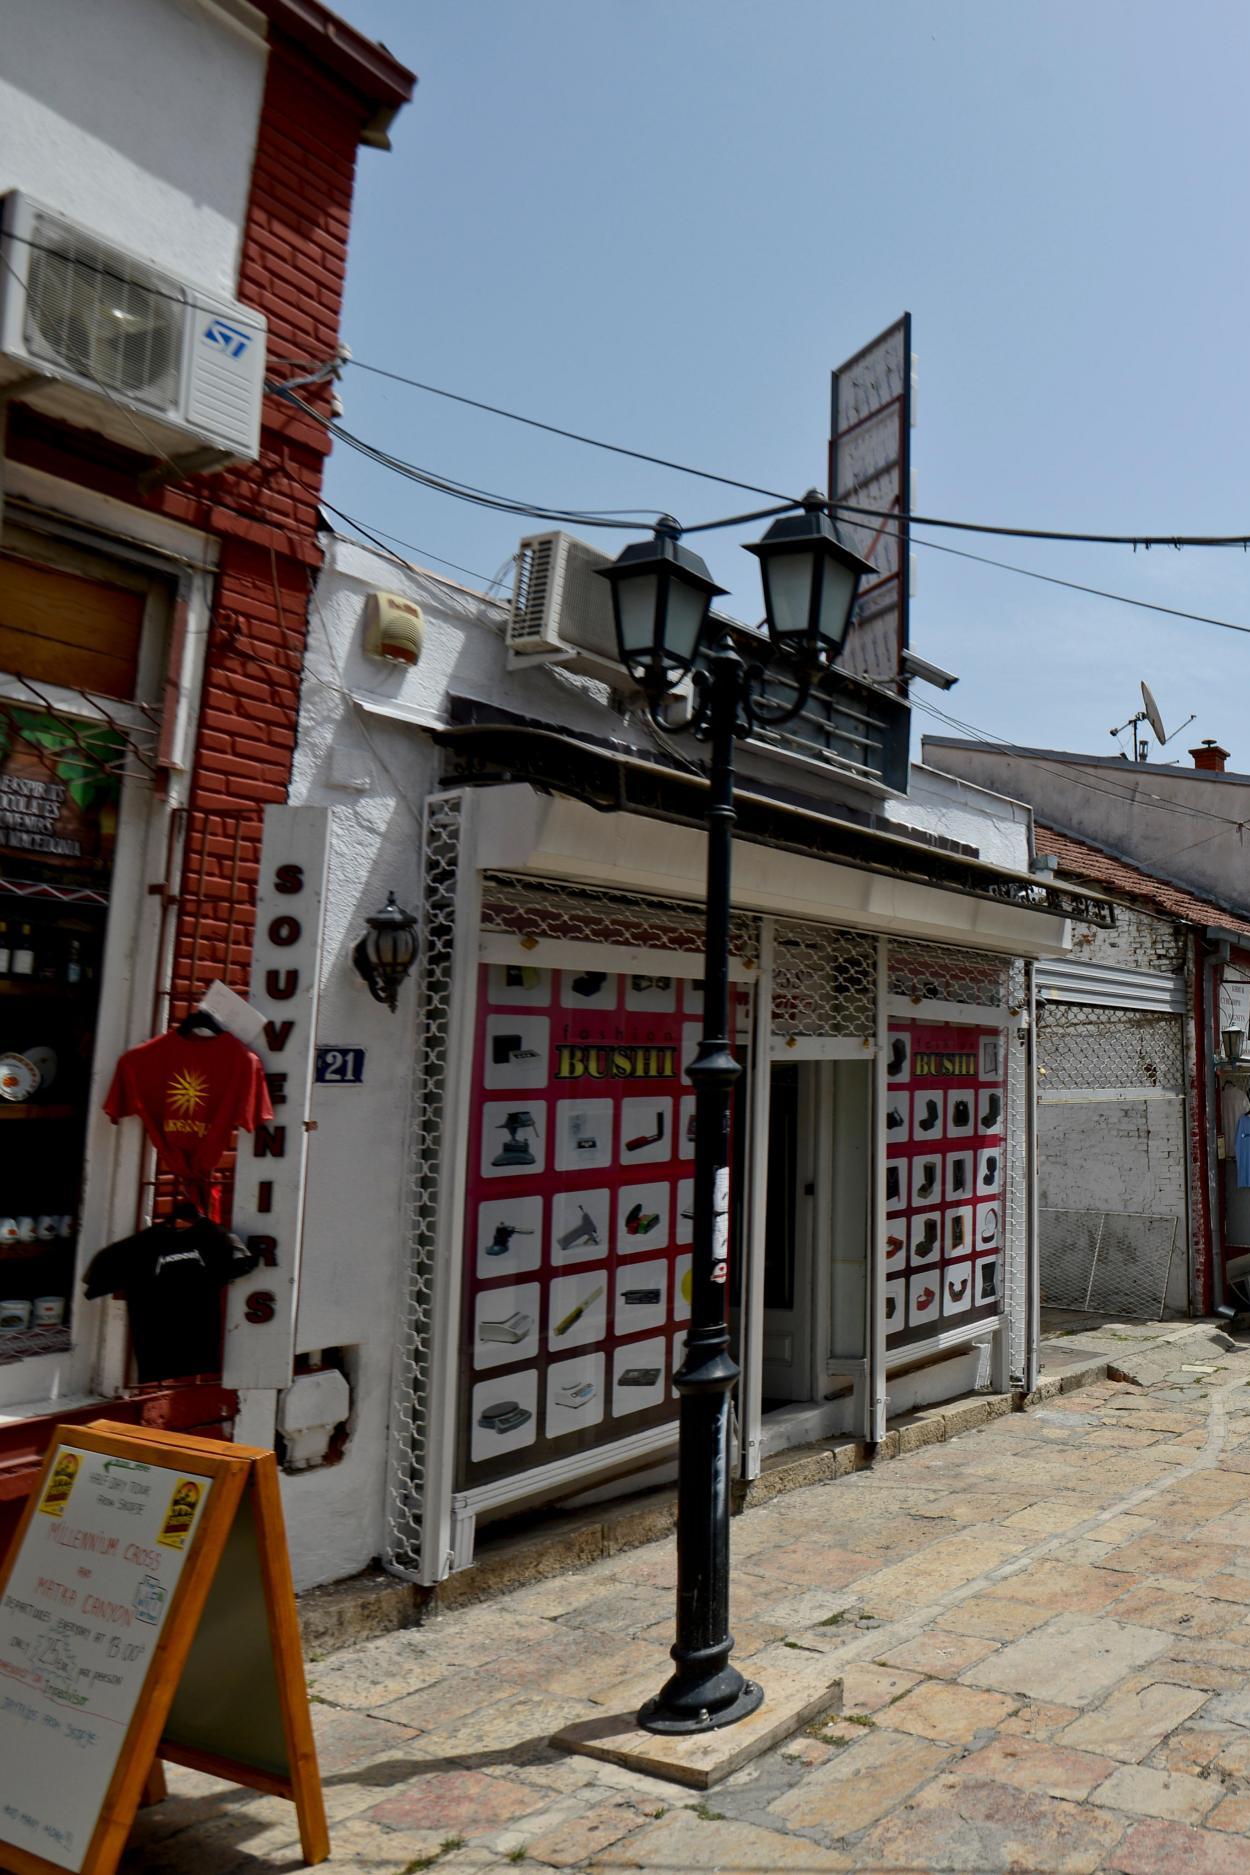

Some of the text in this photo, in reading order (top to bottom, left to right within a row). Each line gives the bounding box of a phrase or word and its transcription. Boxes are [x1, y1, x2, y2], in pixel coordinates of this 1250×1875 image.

[563, 1023, 673, 1041] fashion
[324, 1051, 356, 1081] 21
[554, 1044, 677, 1080] BUSHI
[913, 1052, 977, 1078] BUSHI
[244, 864, 303, 1325] SOUVENIRS
[123, 1542, 162, 1571] CROSS
[82, 1594, 133, 1628] CANYON
